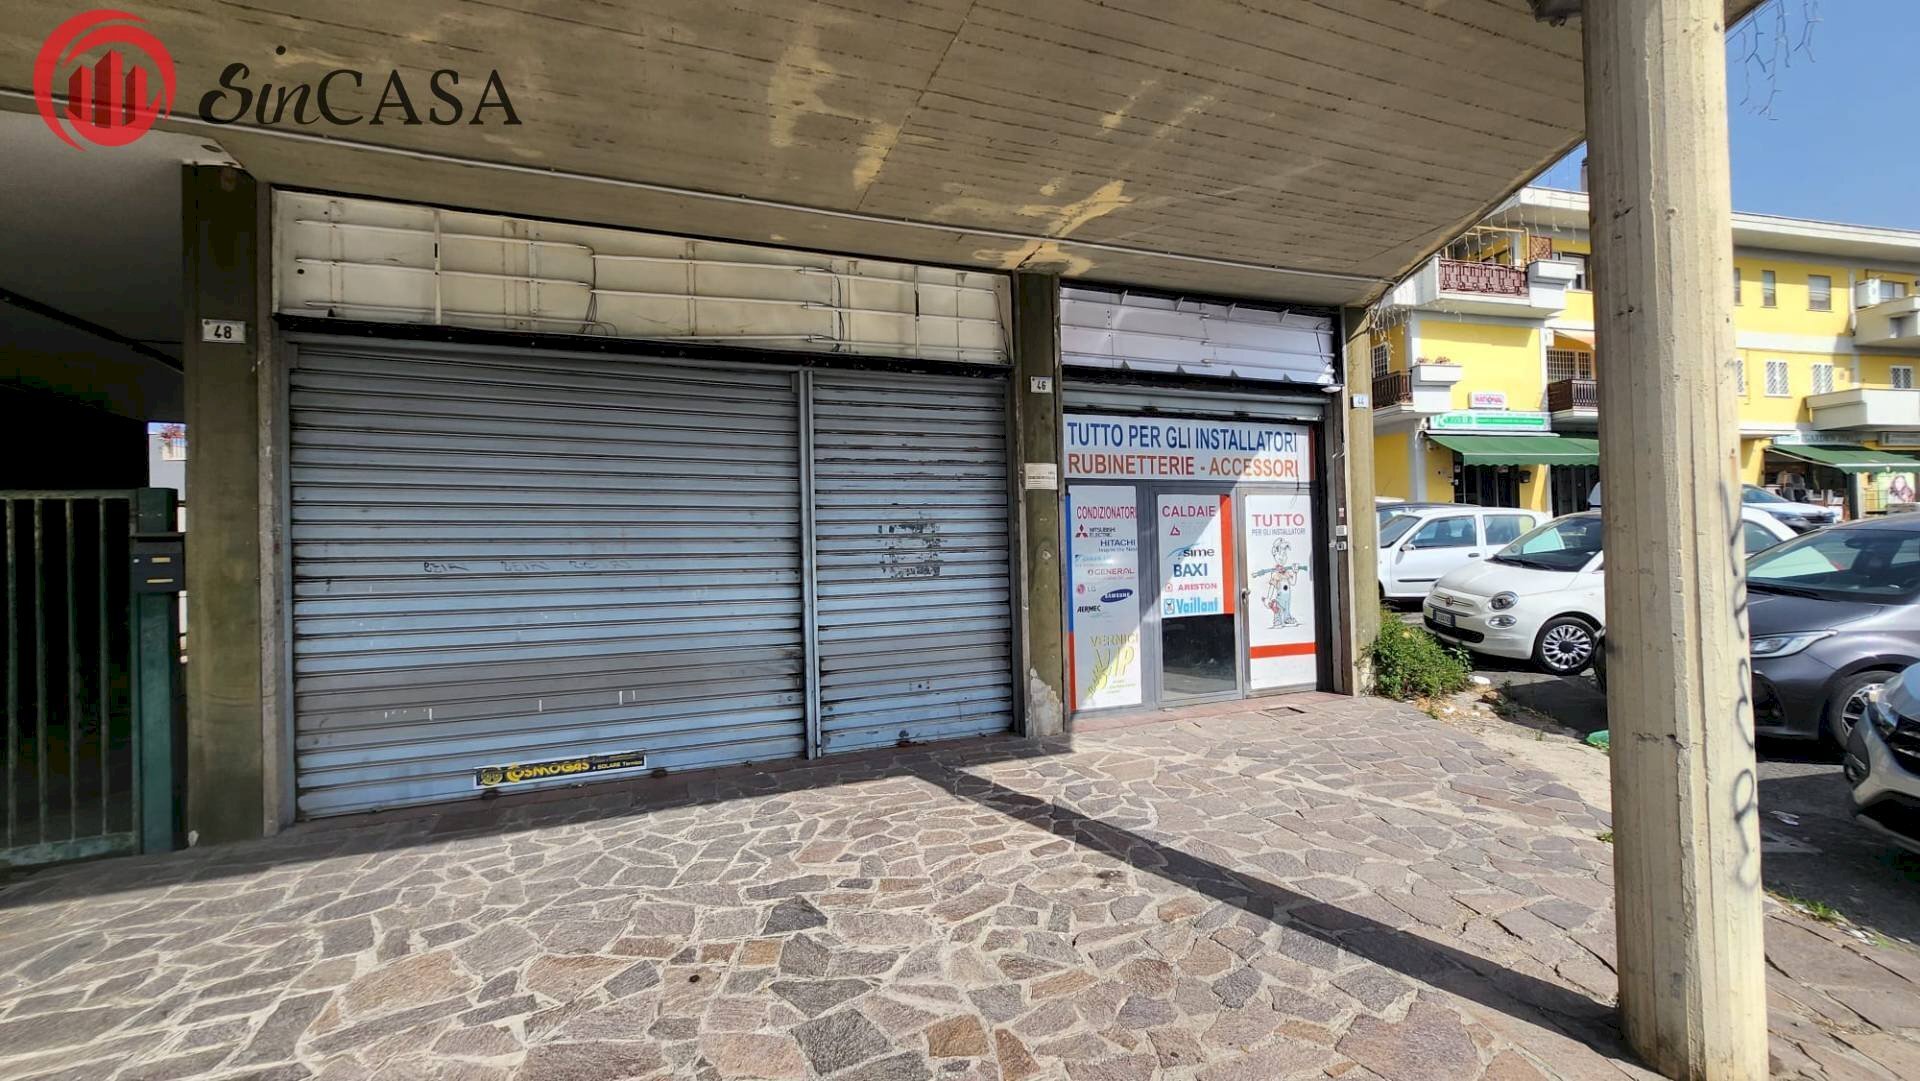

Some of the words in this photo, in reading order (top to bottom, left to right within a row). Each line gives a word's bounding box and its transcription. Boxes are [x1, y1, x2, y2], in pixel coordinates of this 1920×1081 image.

[213, 324, 233, 340] 48
[1036, 380, 1047, 391] 46
[1067, 421, 1124, 448] TUTTO
[1128, 425, 1161, 449] PER
[1165, 427, 1191, 450] GLI
[1195, 428, 1298, 453] INSTALLATORI
[1067, 452, 1195, 476] RUBINETTERIE
[1208, 456, 1299, 478] ACCESSORI
[1162, 505, 1216, 518] CALDAIE
[1251, 513, 1305, 527] TUTTO
[1251, 528, 1262, 536] PER
[1272, 527, 1306, 536] INSTALLATORI
[1100, 538, 1136, 547] HITACHI
[1183, 548, 1215, 558] sime
[1095, 567, 1136, 575] GENERAL
[1173, 563, 1208, 577] BAXI
[1178, 583, 1218, 591] ARISTON
[1077, 605, 1102, 613] AERMEC
[1175, 597, 1218, 613] Vaillant
